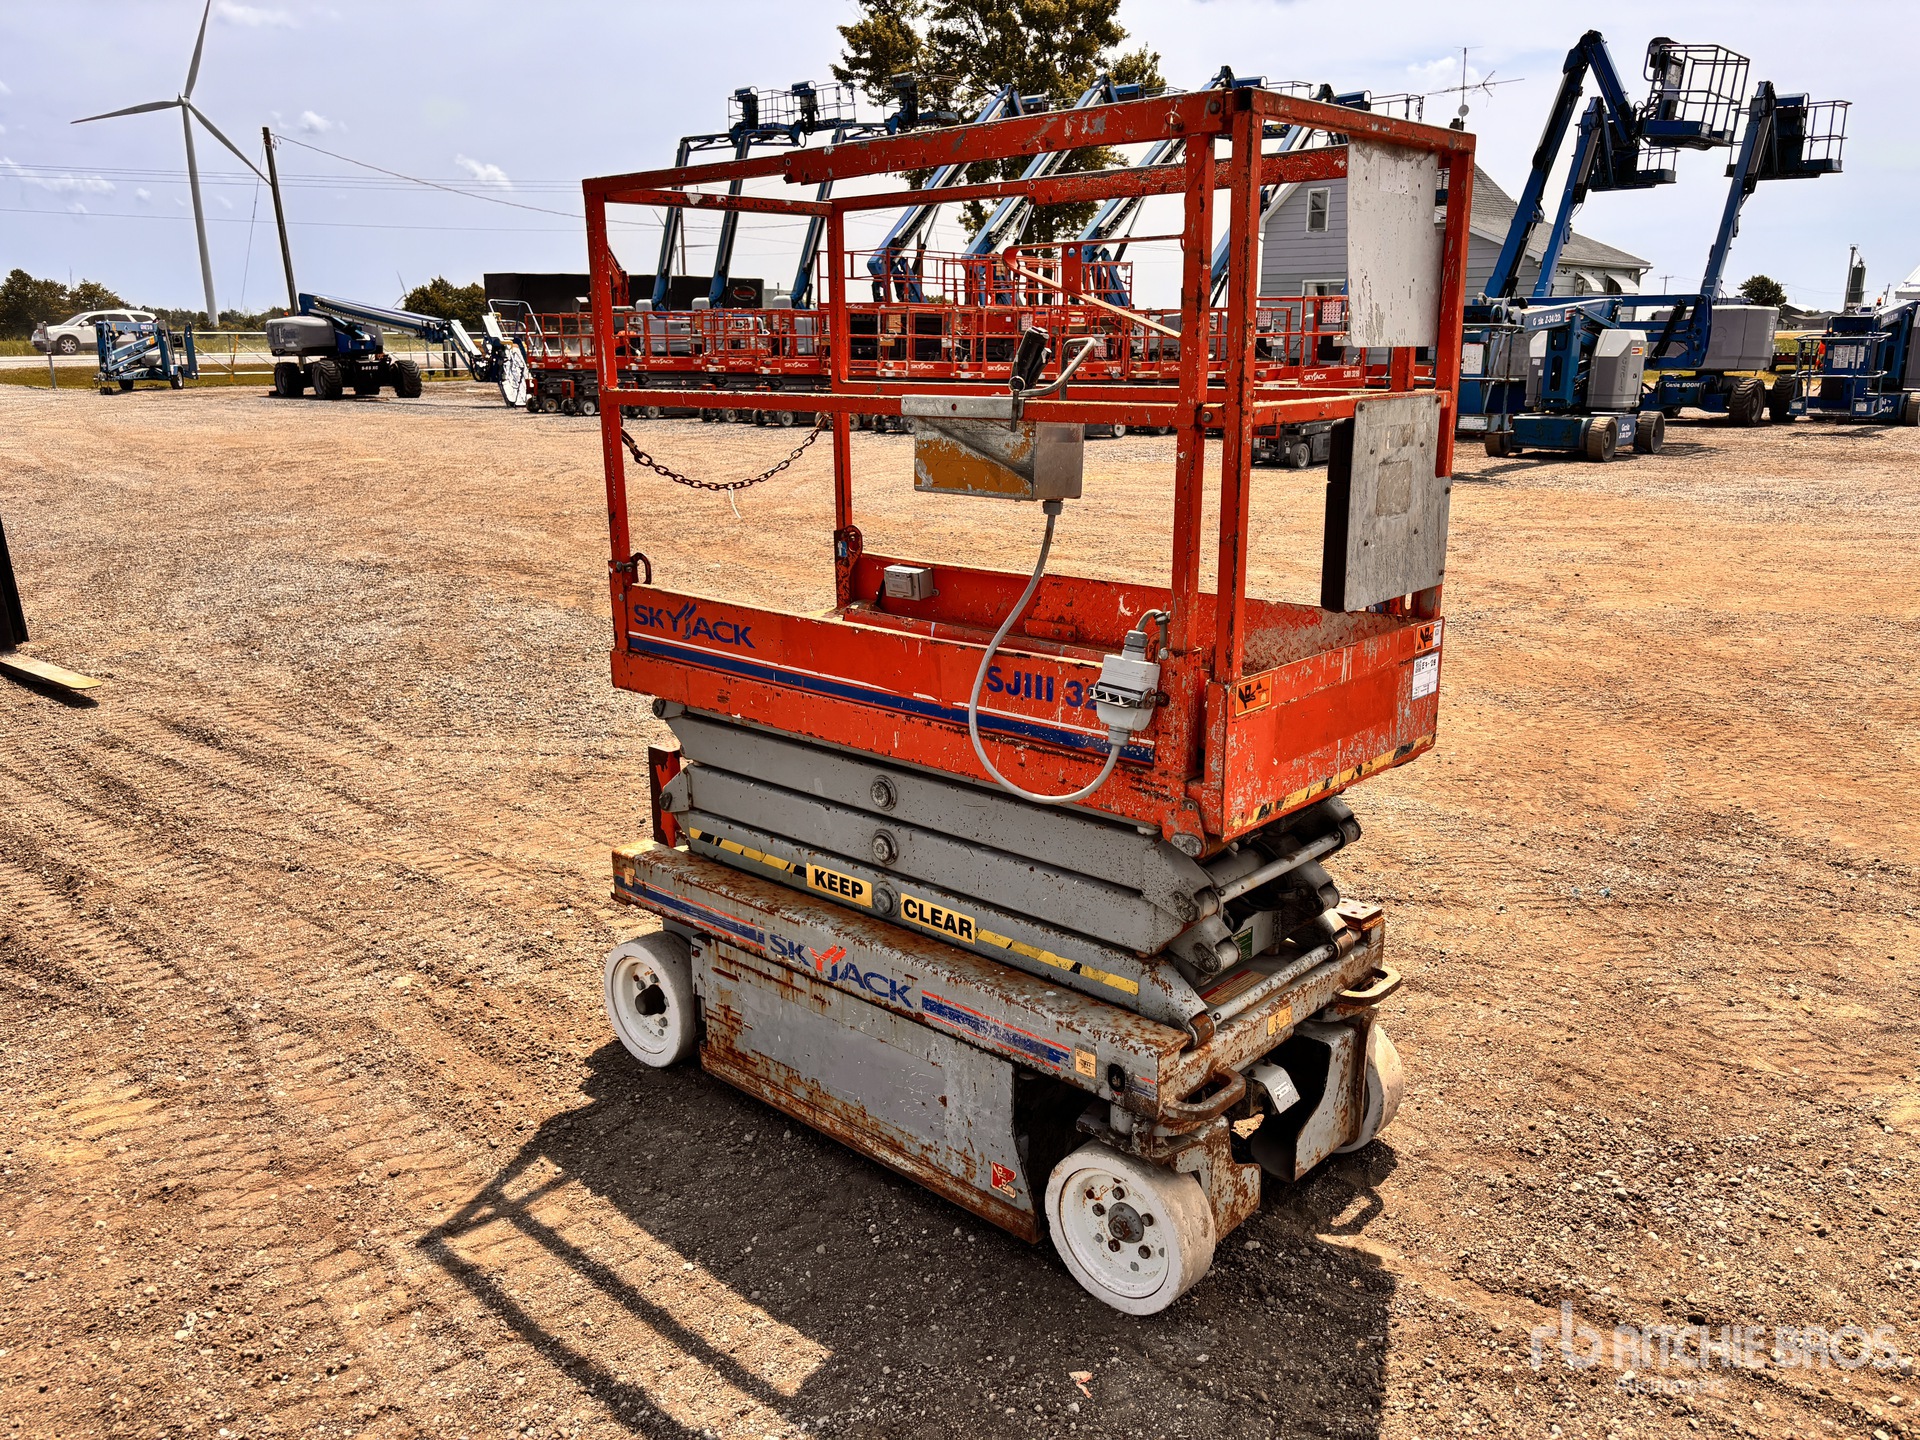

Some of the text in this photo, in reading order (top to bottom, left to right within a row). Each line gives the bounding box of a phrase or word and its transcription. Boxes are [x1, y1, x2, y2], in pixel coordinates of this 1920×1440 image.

[911, 362, 934, 370] SKYJACK
[987, 363, 1011, 372] SKYJACK
[1304, 372, 1326, 381] SKYJACK
[634, 601, 756, 649] SKYJACK
[986, 665, 1054, 702] SJIII
[814, 868, 864, 899] KEEP
[903, 898, 973, 940] CLEAR
[769, 934, 914, 1009] SKYJACK
